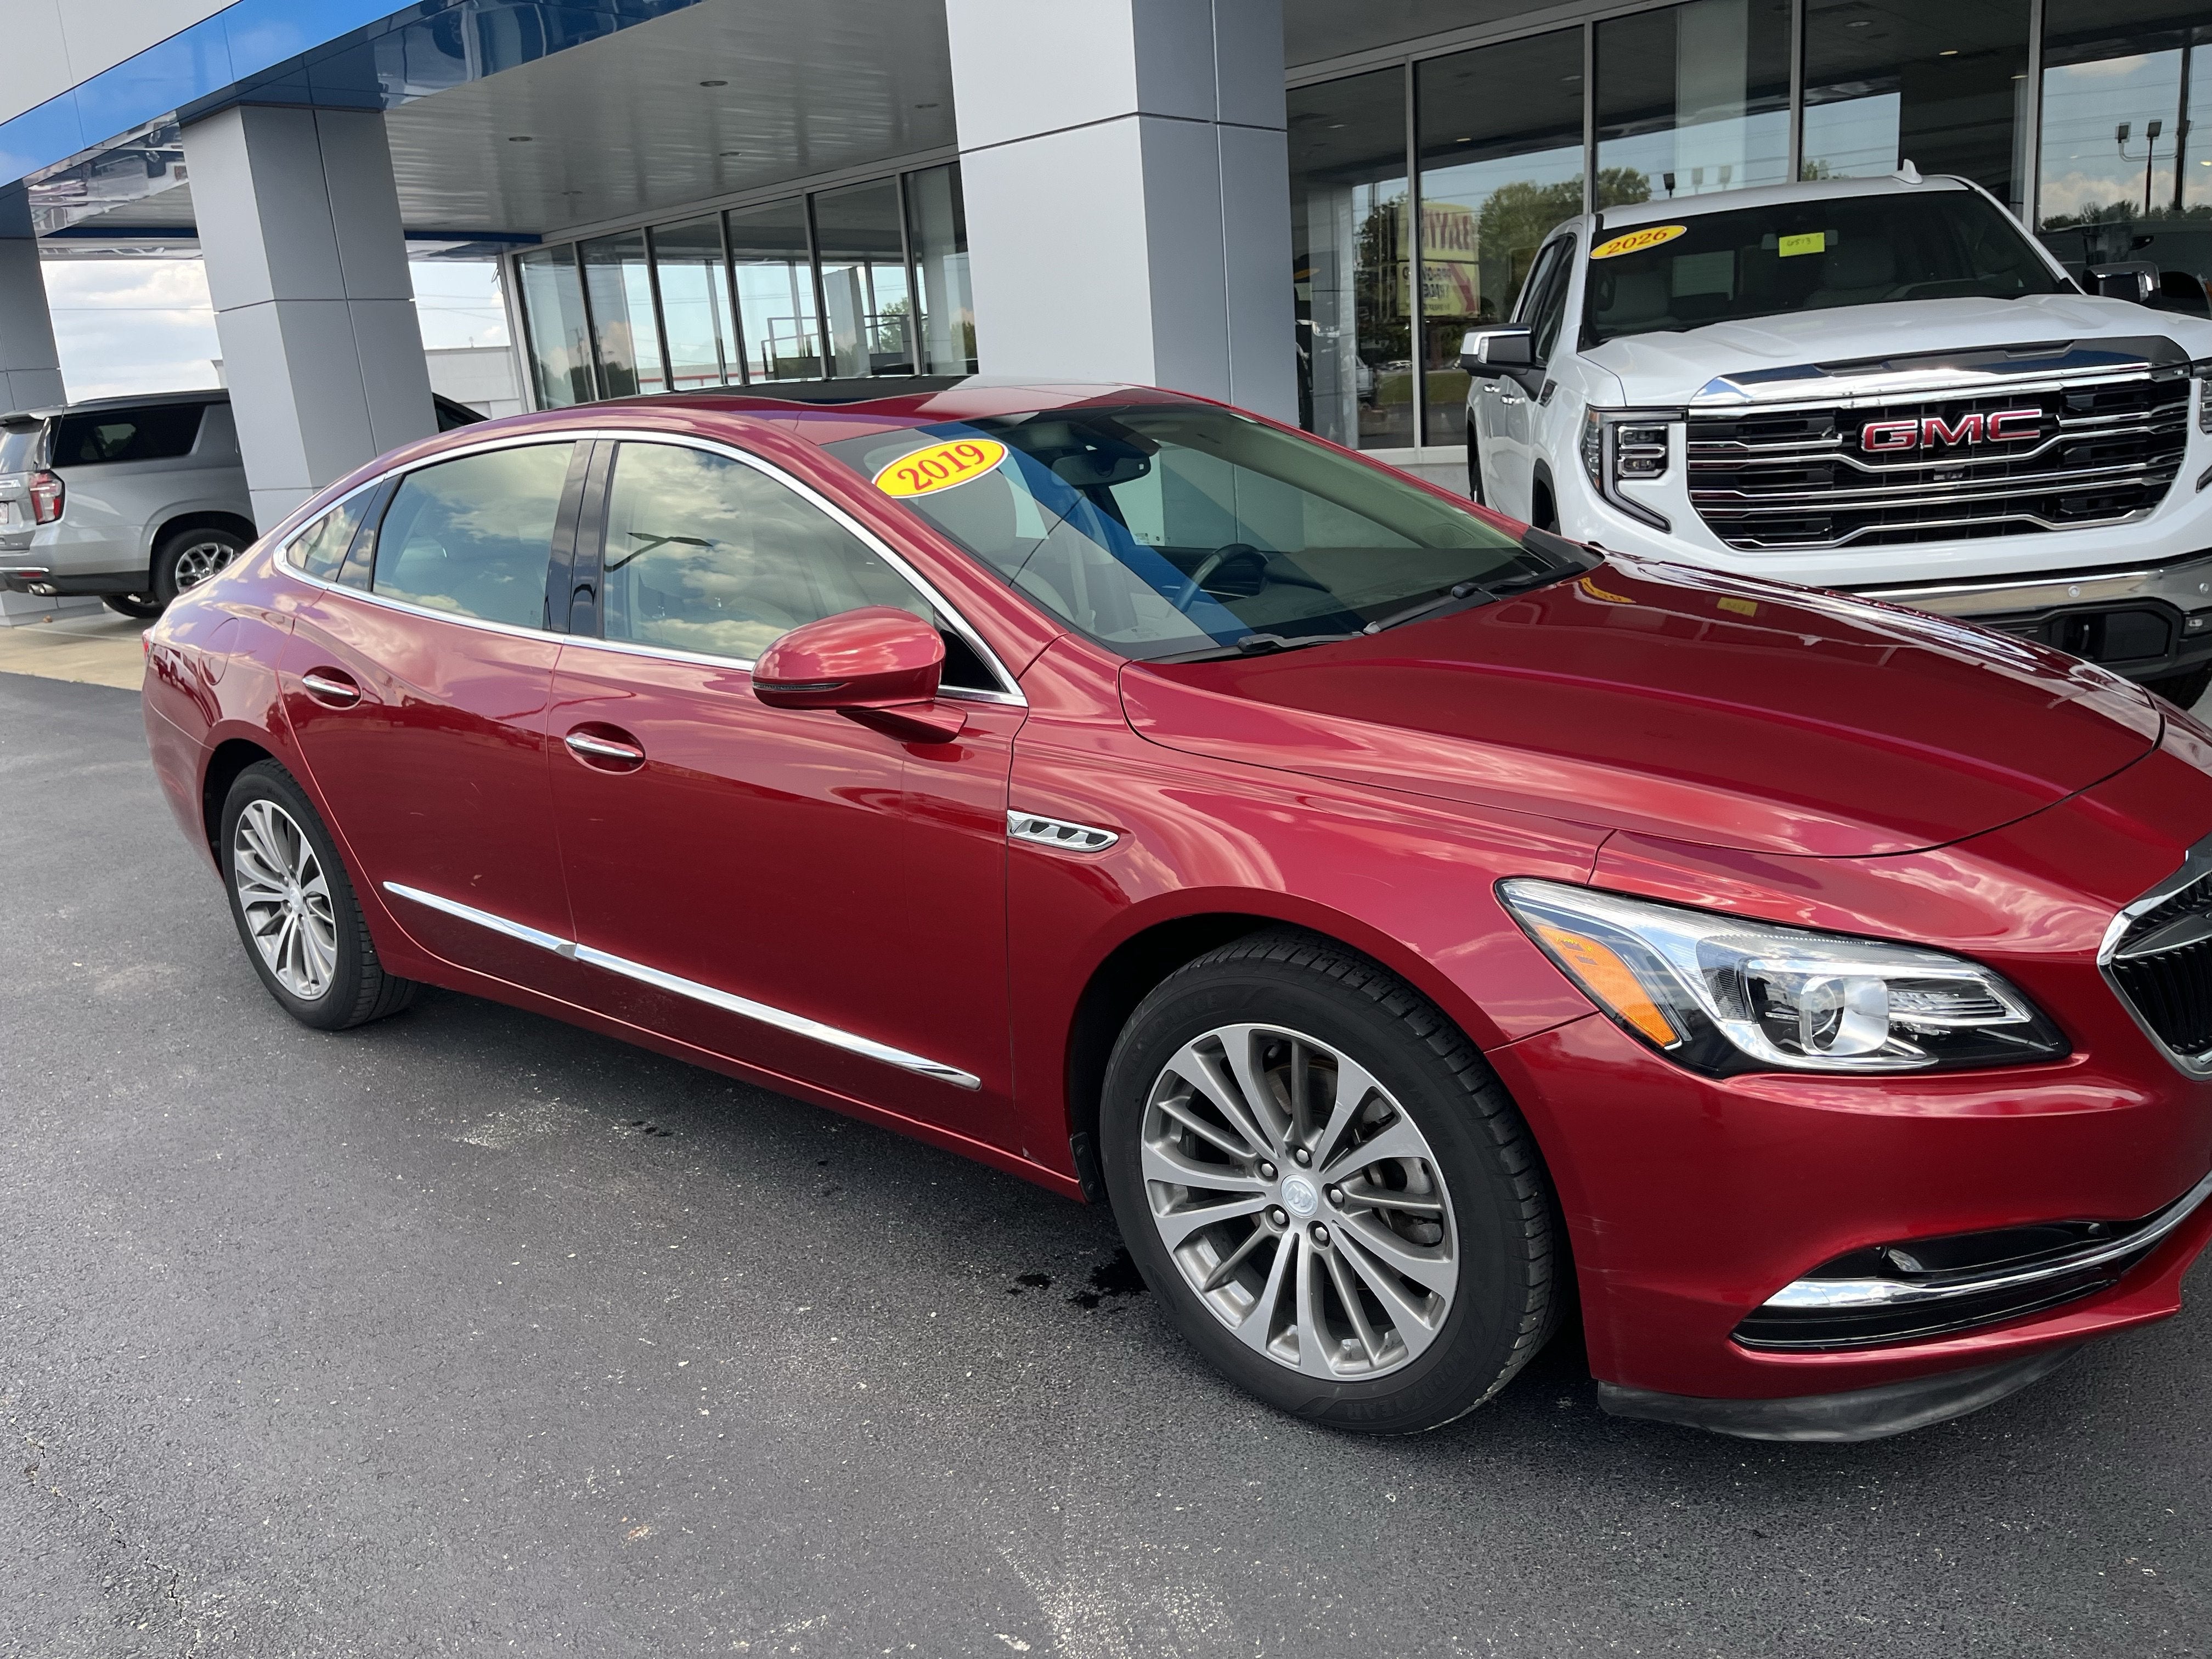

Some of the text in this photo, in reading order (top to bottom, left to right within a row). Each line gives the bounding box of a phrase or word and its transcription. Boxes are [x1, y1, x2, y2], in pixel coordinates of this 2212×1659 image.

[1606, 228, 1669, 255] 2026
[1861, 408, 2042, 453] GMC
[897, 444, 985, 491] 2019
